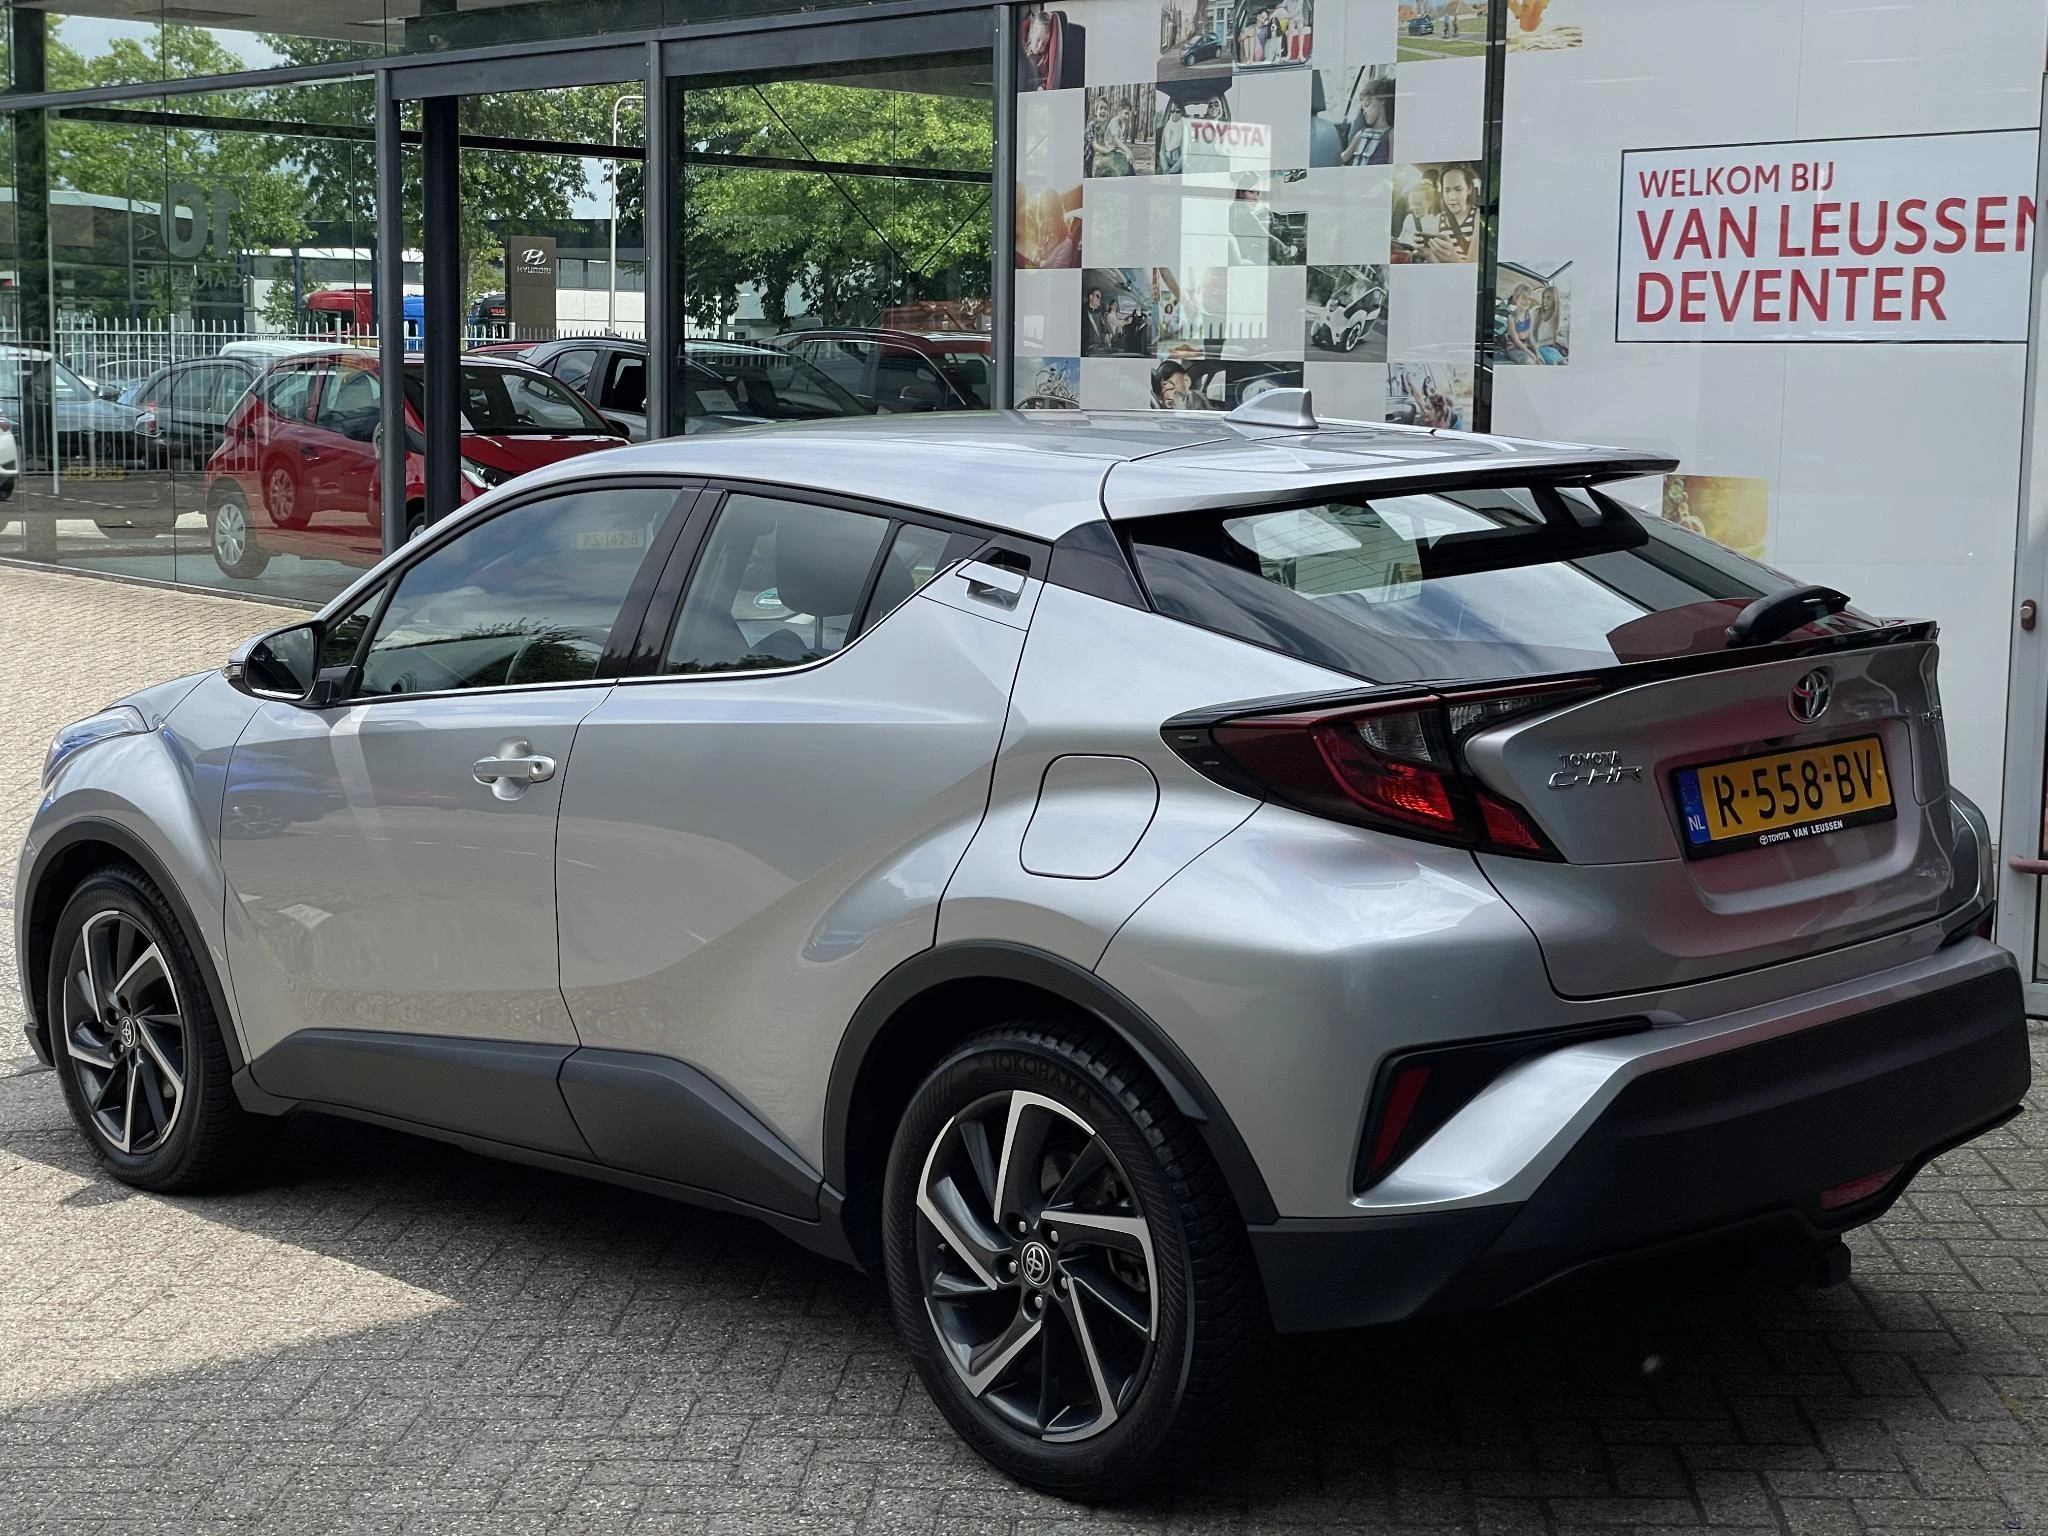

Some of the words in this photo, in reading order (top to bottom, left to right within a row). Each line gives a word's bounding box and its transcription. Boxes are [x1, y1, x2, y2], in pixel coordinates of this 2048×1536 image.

[1191, 122, 1263, 146] TOYOTA
[1639, 164, 1780, 198] WELKOM
[1791, 161, 1834, 192] BIJ
[1637, 205, 1757, 260] VAN
[517, 266, 552, 274] HYUNDAI
[1636, 267, 1947, 323] DEVENTER
[1558, 750, 1622, 769] TOYOTA
[1712, 749, 1873, 828] R-558-BV
[1688, 815, 1706, 832] NL
[1768, 831, 1791, 843] TOYOTA
[1793, 827, 1809, 838] VAN
[1811, 819, 1843, 834] LEUSSEN
[989, 1054, 1093, 1106] YOKOHAMA
